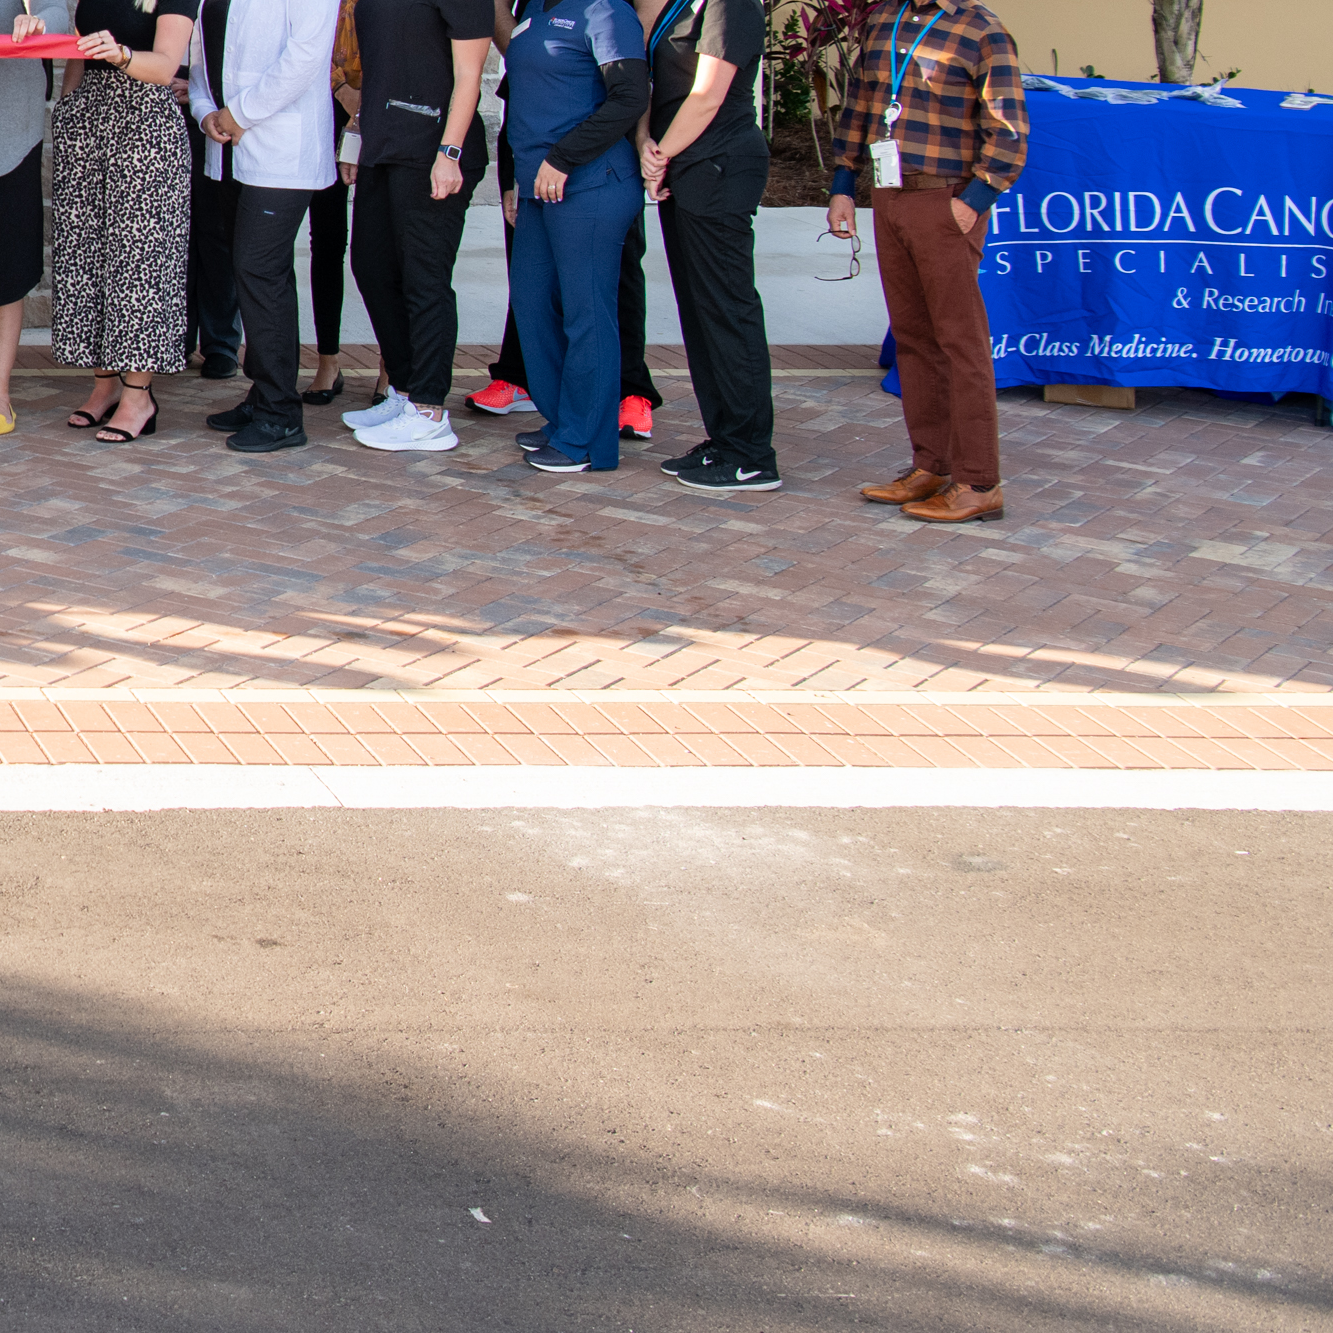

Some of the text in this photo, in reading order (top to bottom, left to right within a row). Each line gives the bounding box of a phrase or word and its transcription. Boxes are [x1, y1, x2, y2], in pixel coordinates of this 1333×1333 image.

[990, 189, 1196, 235] FLORIDA
[995, 249, 1327, 279] SPECIALIS
[1171, 286, 1192, 309] &
[1201, 287, 1306, 314] Research
[1084, 333, 1198, 359] Medicine.
